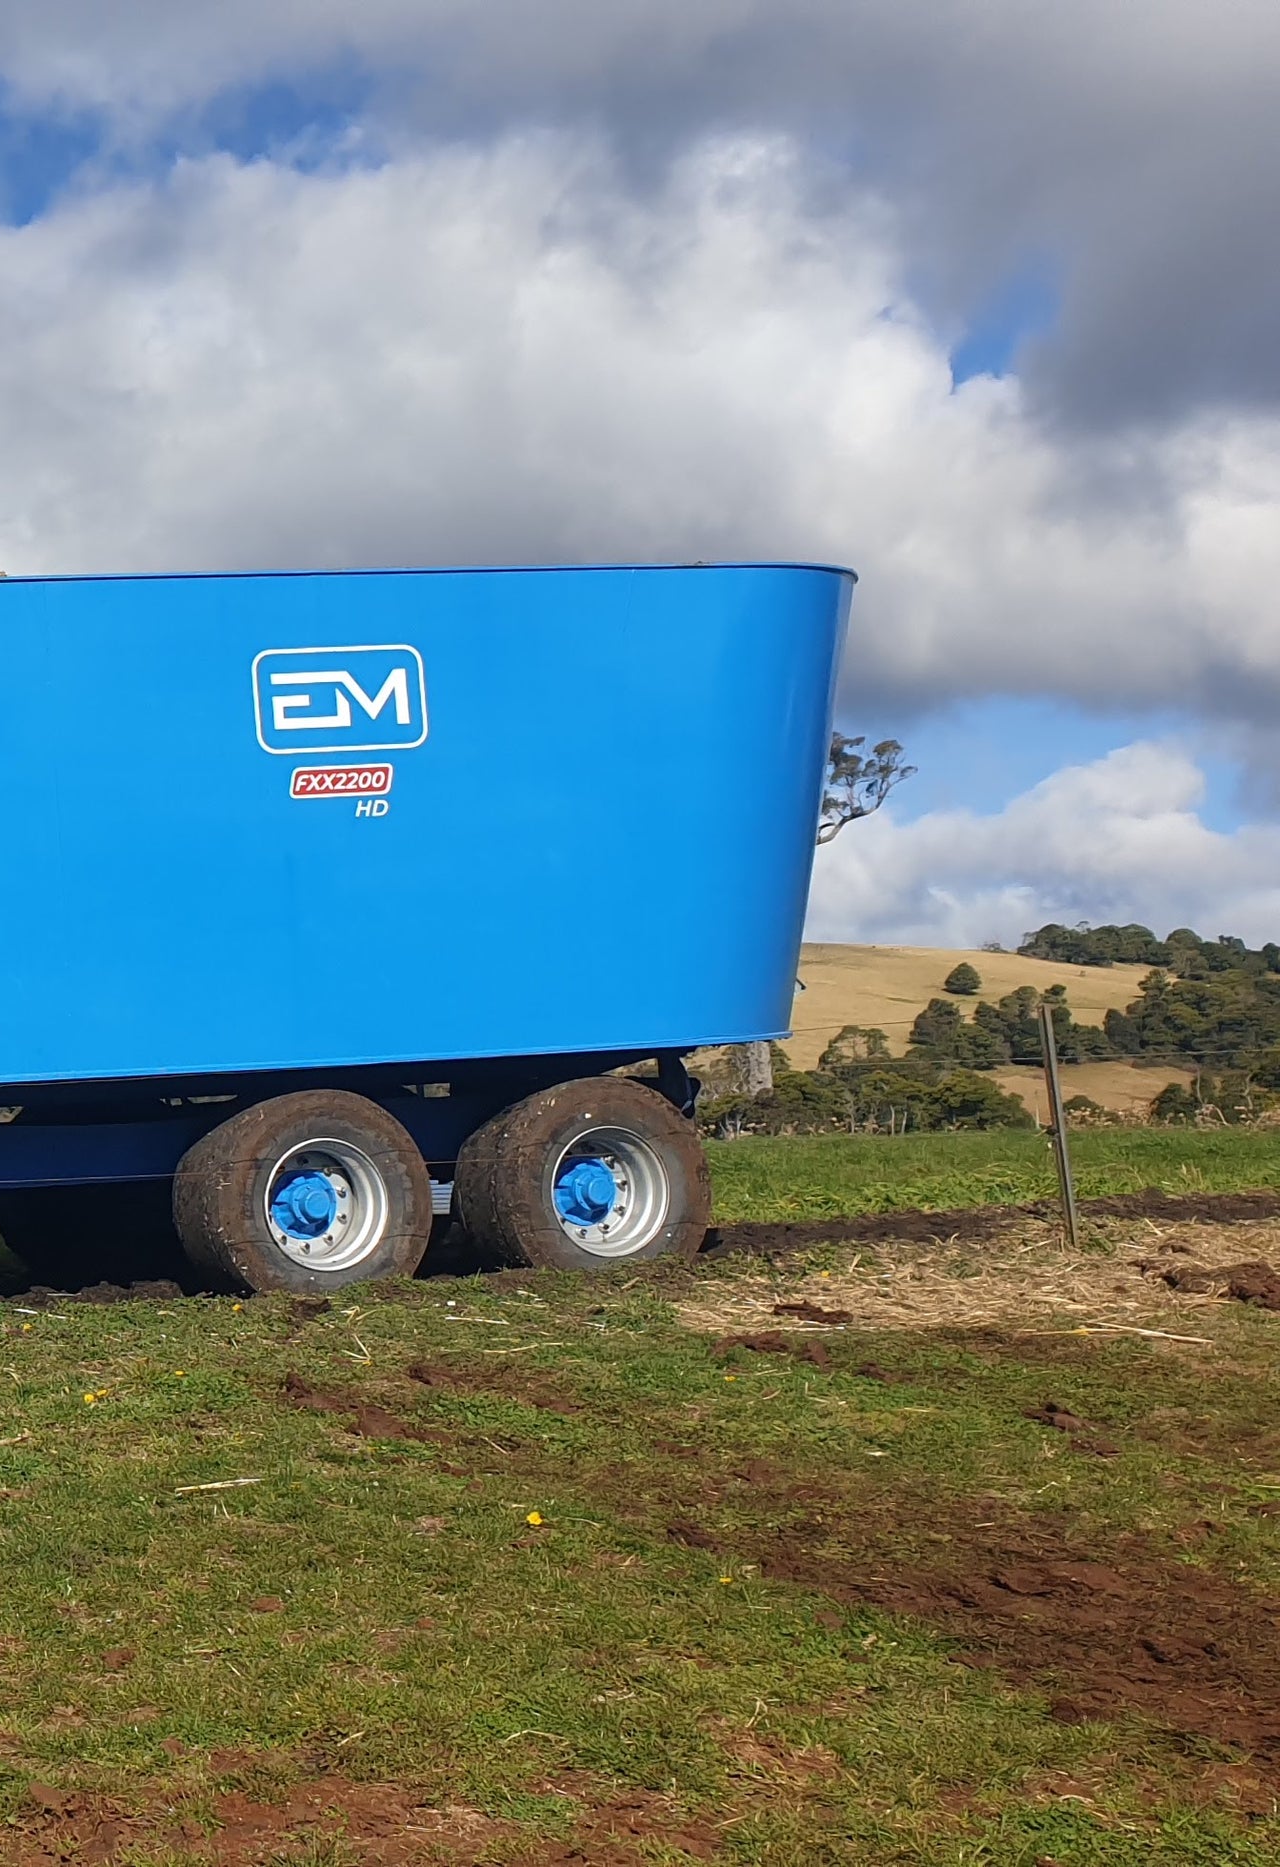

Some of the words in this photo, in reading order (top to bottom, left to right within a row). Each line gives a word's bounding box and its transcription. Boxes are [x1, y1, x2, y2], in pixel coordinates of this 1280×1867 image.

[271, 669, 410, 730] EM
[295, 771, 386, 792] FXX2200
[355, 800, 389, 817] HD
